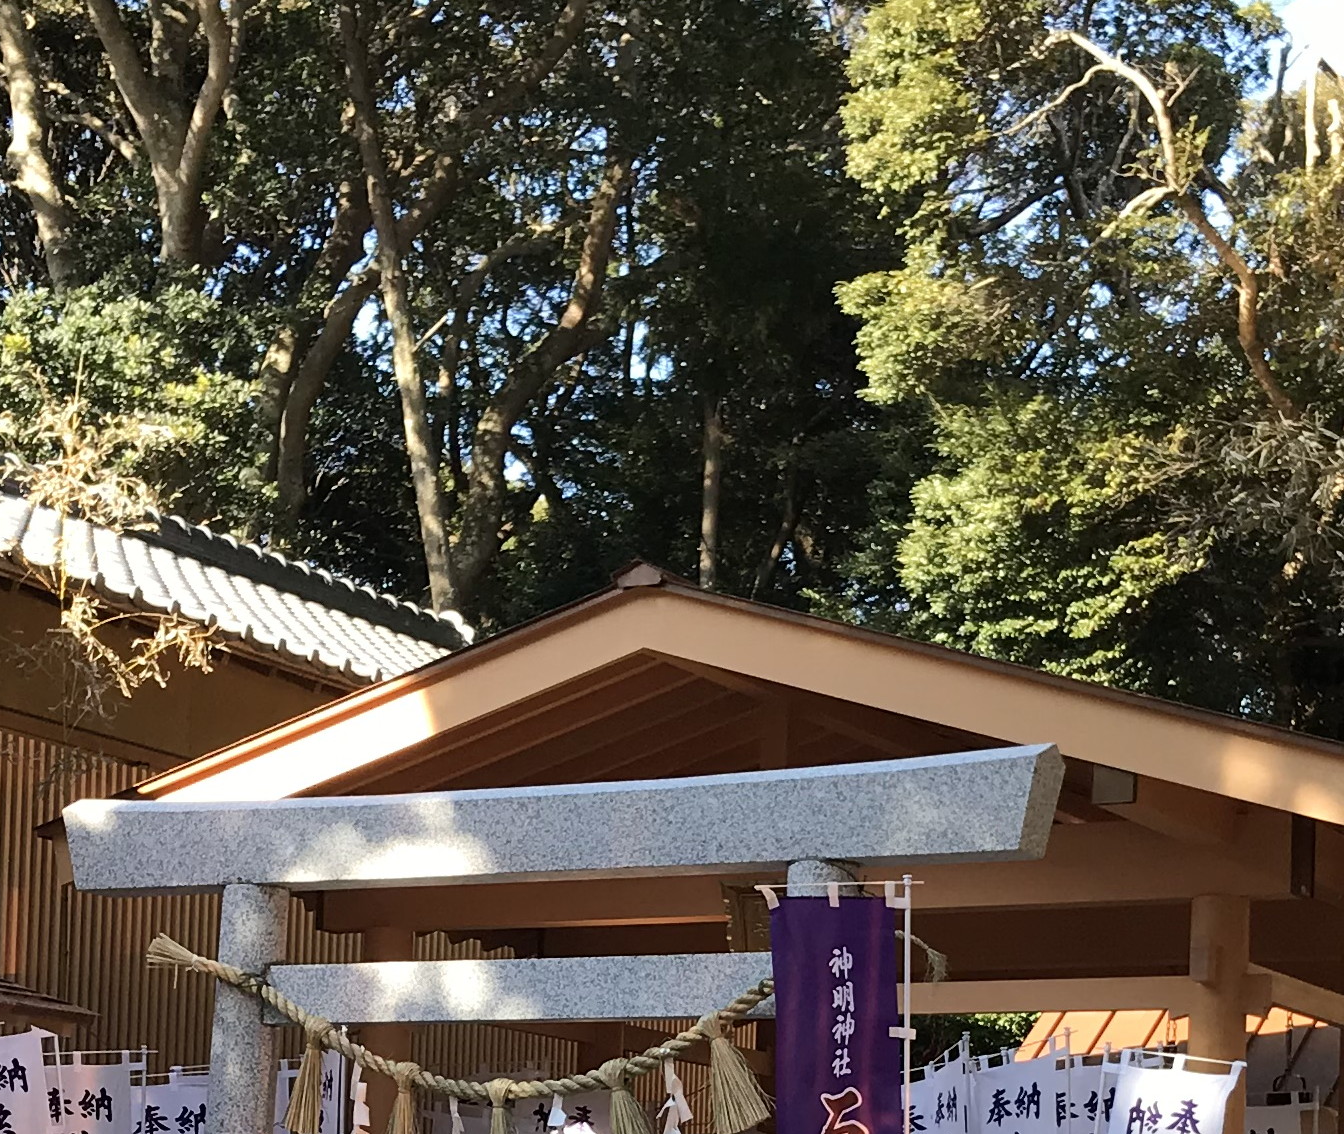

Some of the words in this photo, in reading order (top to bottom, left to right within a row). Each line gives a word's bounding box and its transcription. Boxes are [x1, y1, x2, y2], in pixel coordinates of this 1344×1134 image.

[827, 945, 855, 1079] 神明神社
[46, 1086, 114, 1123] 奉納
[934, 1085, 958, 1125] 奉納
[986, 1081, 1042, 1128] 奉納
